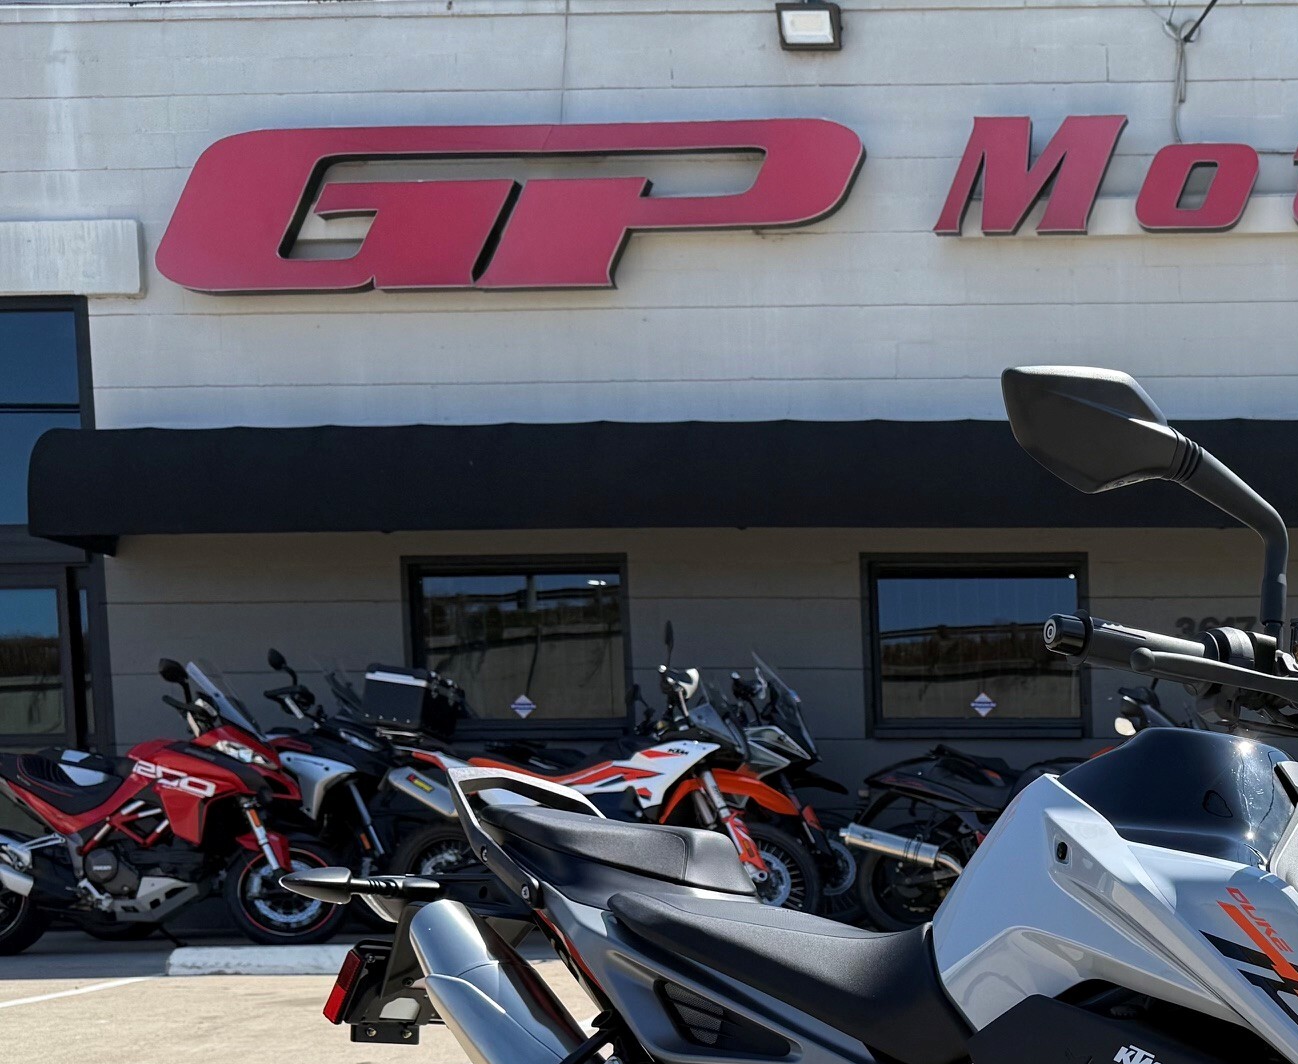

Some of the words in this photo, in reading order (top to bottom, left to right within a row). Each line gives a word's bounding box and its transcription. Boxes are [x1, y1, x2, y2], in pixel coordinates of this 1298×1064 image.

[154, 117, 867, 294] GP
[668, 748, 690, 756] KTM
[1225, 886, 1295, 953] DUKE
